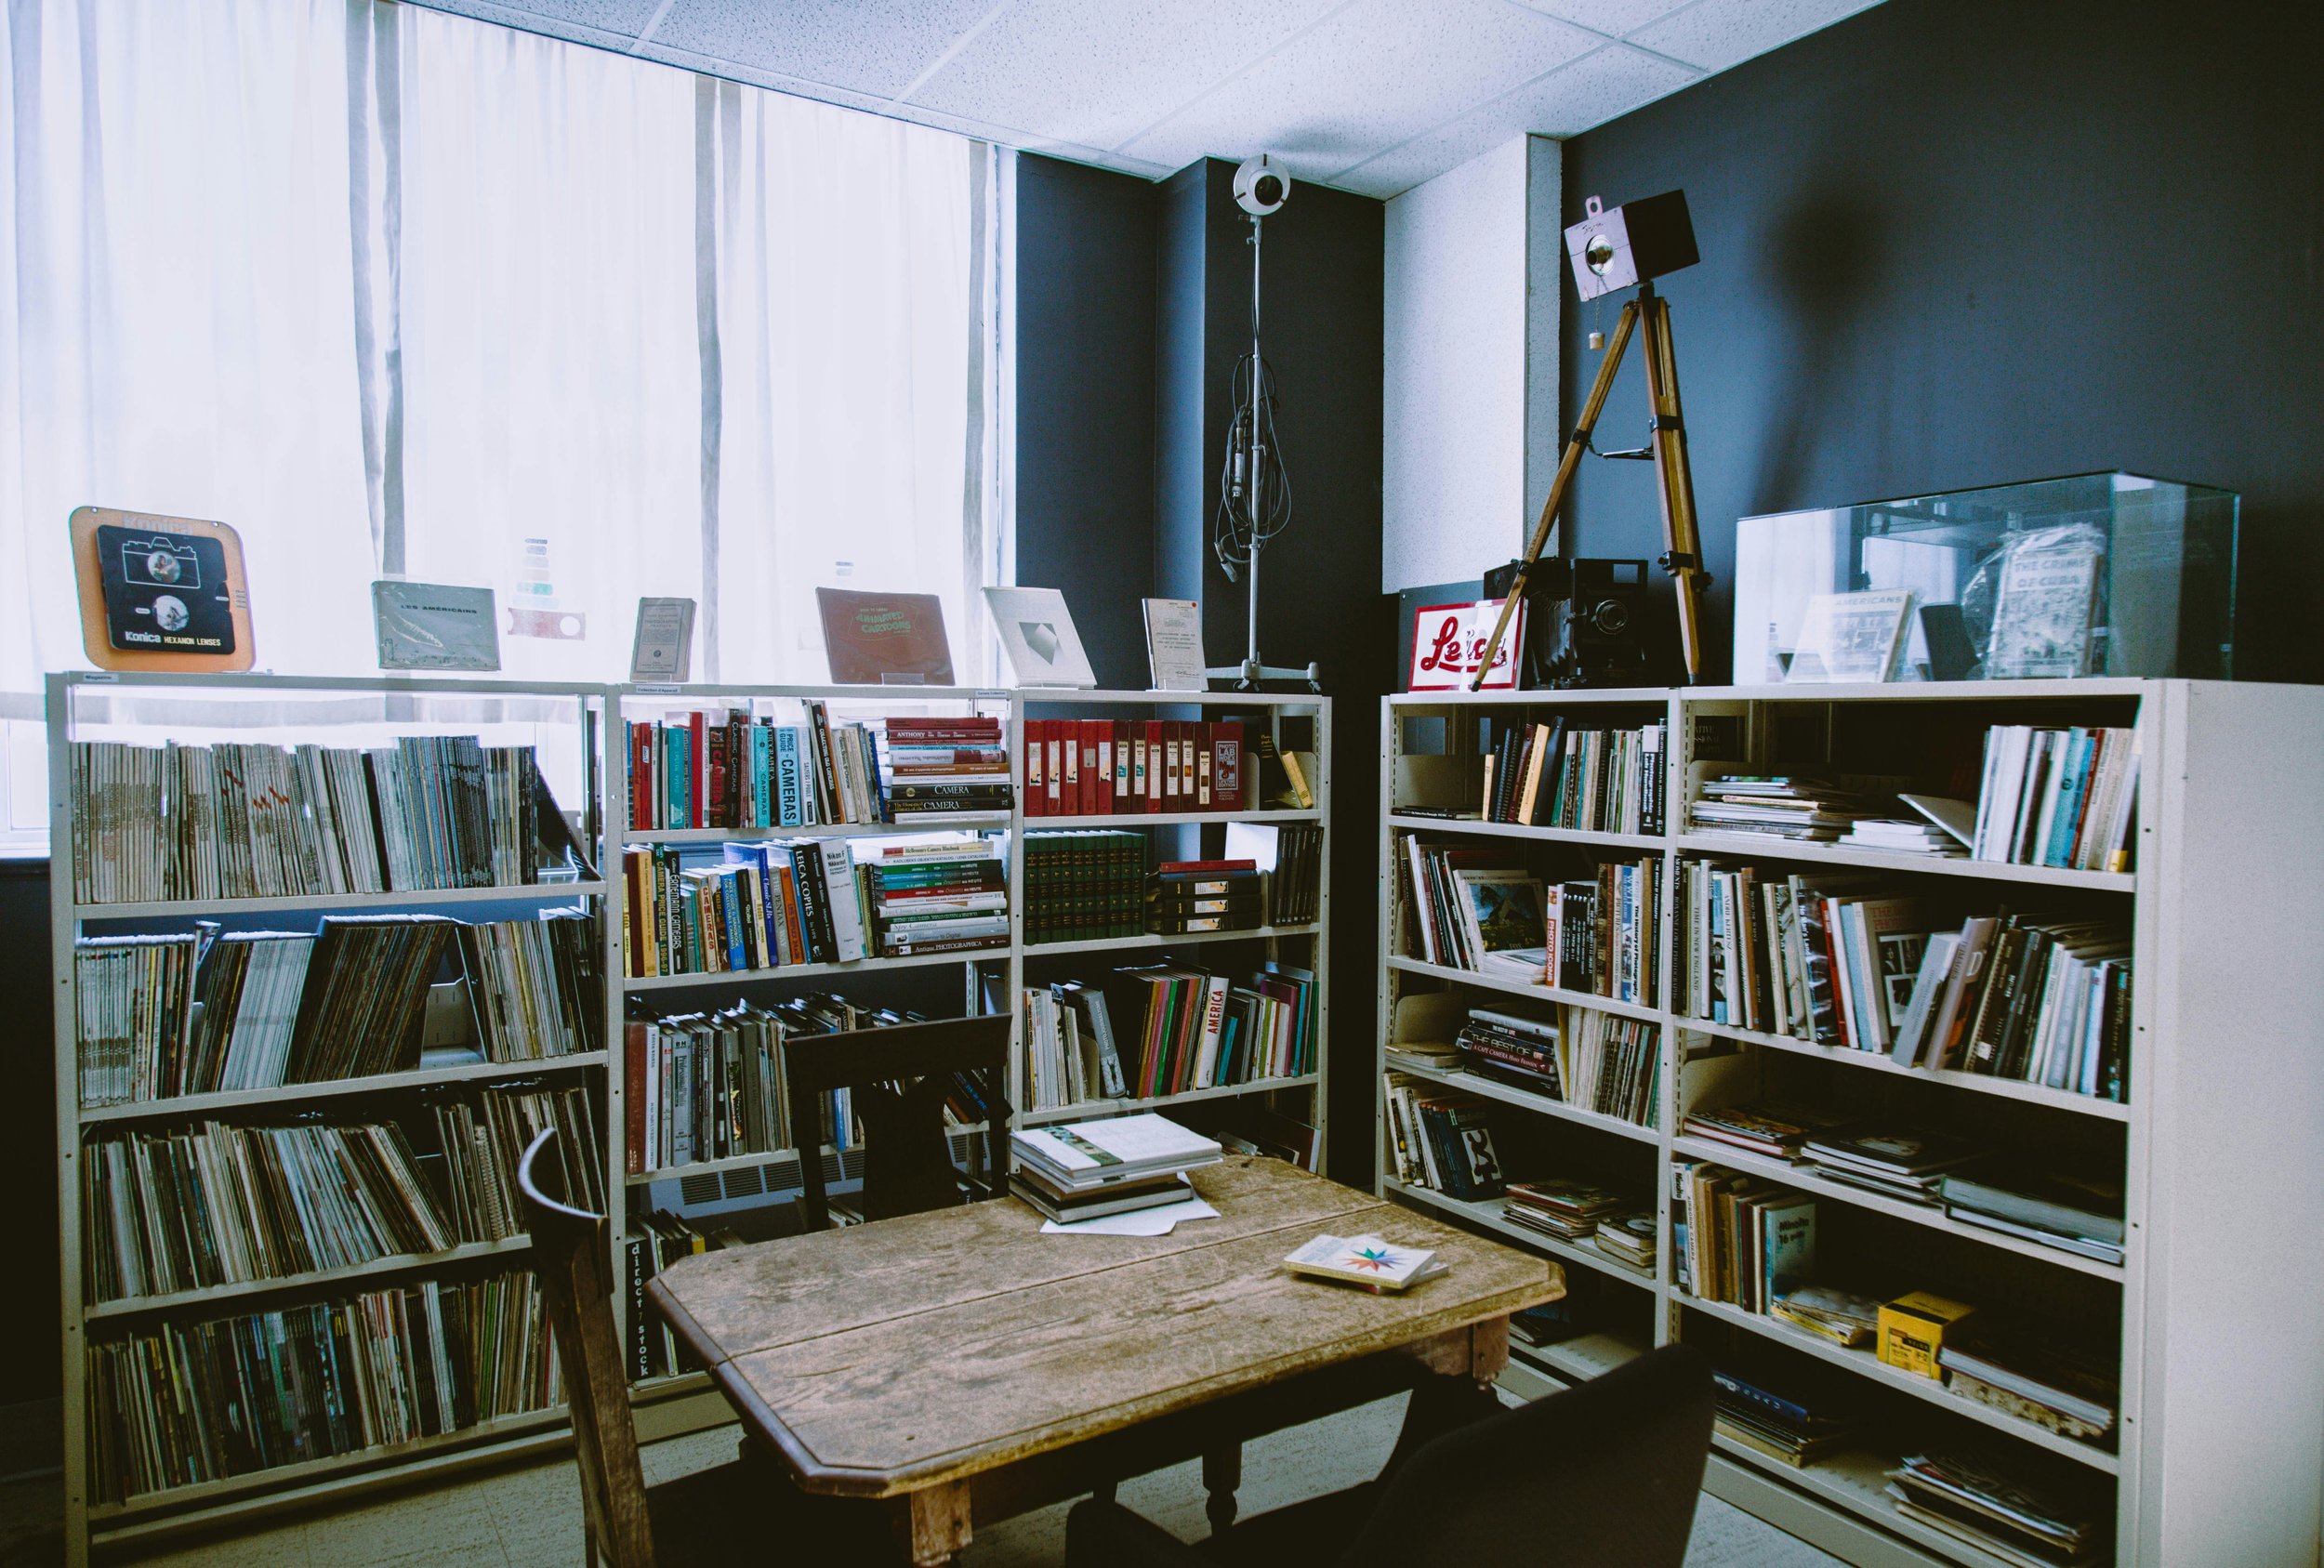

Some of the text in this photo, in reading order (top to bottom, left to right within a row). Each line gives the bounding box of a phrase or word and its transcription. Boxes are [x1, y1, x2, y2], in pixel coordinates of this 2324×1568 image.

[1836, 596, 1903, 606] AMERICANS
[125, 631, 161, 643] Konica
[165, 637, 194, 645] HEXANON
[862, 621, 912, 634] CARTOONS
[712, 750, 723, 804] CAMERA
[782, 759, 796, 820] CAMERAS
[934, 785, 970, 795] CAMERA
[923, 801, 959, 810] CAMERA
[827, 853, 840, 862] Nikon
[656, 862, 665, 892] CAMERA
[795, 850, 814, 917] LEICA COPIES
[763, 878, 773, 919] Classic SLRs
[670, 875, 681, 949] ERNEMANN CAMERAS
[703, 888, 716, 950] CAMERAS
[774, 894, 785, 928] PENTAX
[1799, 905, 1806, 916] No
[1694, 927, 1699, 935] IN
[935, 942, 983, 951] PHOTOGRAPHICA
[1207, 991, 1223, 1034] AMERICA
[1472, 1034, 1489, 1045] THE
[1490, 1036, 1514, 1054] BEST
[1514, 1045, 1532, 1056] OF
[1489, 1048, 1508, 1061] CAMERA
[1675, 1172, 1684, 1198] Minolta
[1779, 1217, 1809, 1232] Minolta
[631, 1244, 649, 1377] direct stock
